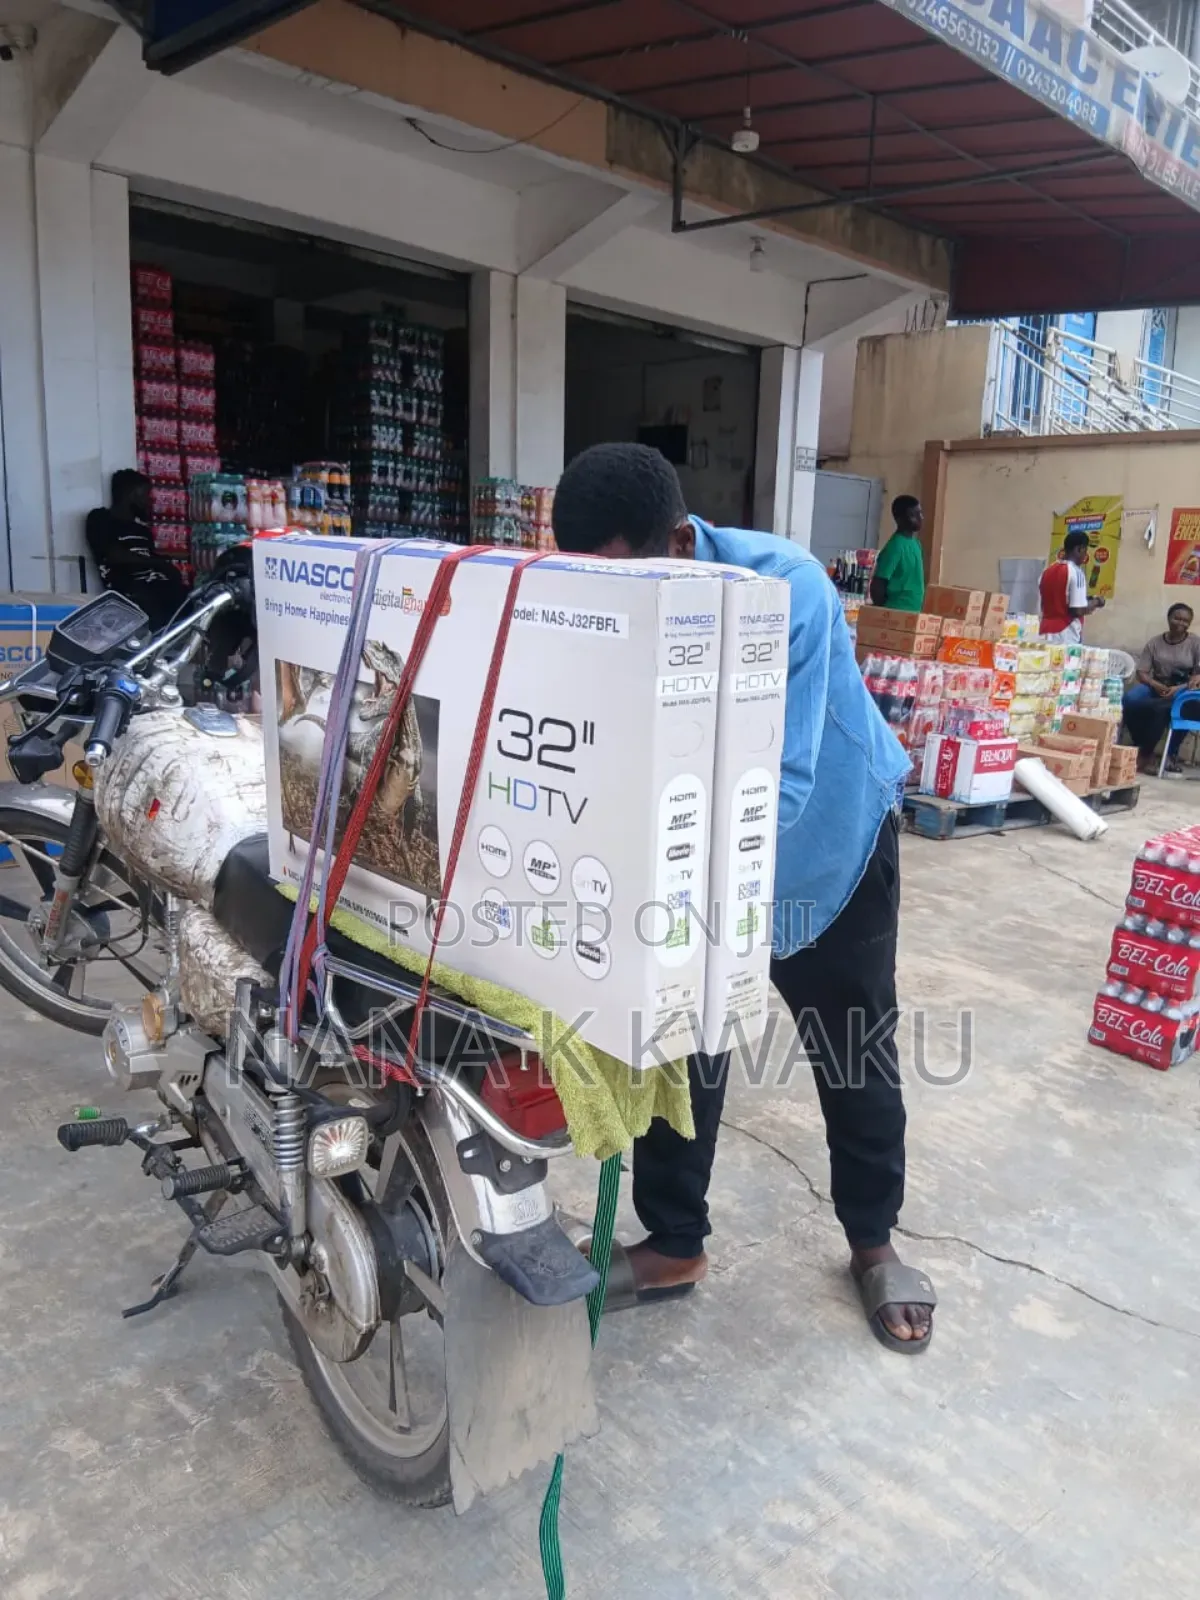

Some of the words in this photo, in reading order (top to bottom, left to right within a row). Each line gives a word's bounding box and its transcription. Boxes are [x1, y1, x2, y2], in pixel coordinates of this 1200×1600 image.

[950, 0, 1099, 85] AAC
[264, 597, 282, 617] Bring
[284, 602, 308, 619] Home
[309, 605, 350, 626] Happines
[513, 606, 539, 622] odel:
[541, 608, 620, 633] NAS-J32FBFL
[674, 614, 716, 626] NASCO
[747, 613, 785, 625] NASCO
[668, 641, 711, 667] 32"
[741, 639, 780, 664] 32"
[662, 675, 714, 693] HDTV
[735, 672, 782, 691] HDTV
[497, 707, 595, 774] 32"
[489, 771, 589, 825] HDTV
[1118, 943, 1190, 978] BEL-Cola
[1096, 1008, 1164, 1046] BEL-Cola
